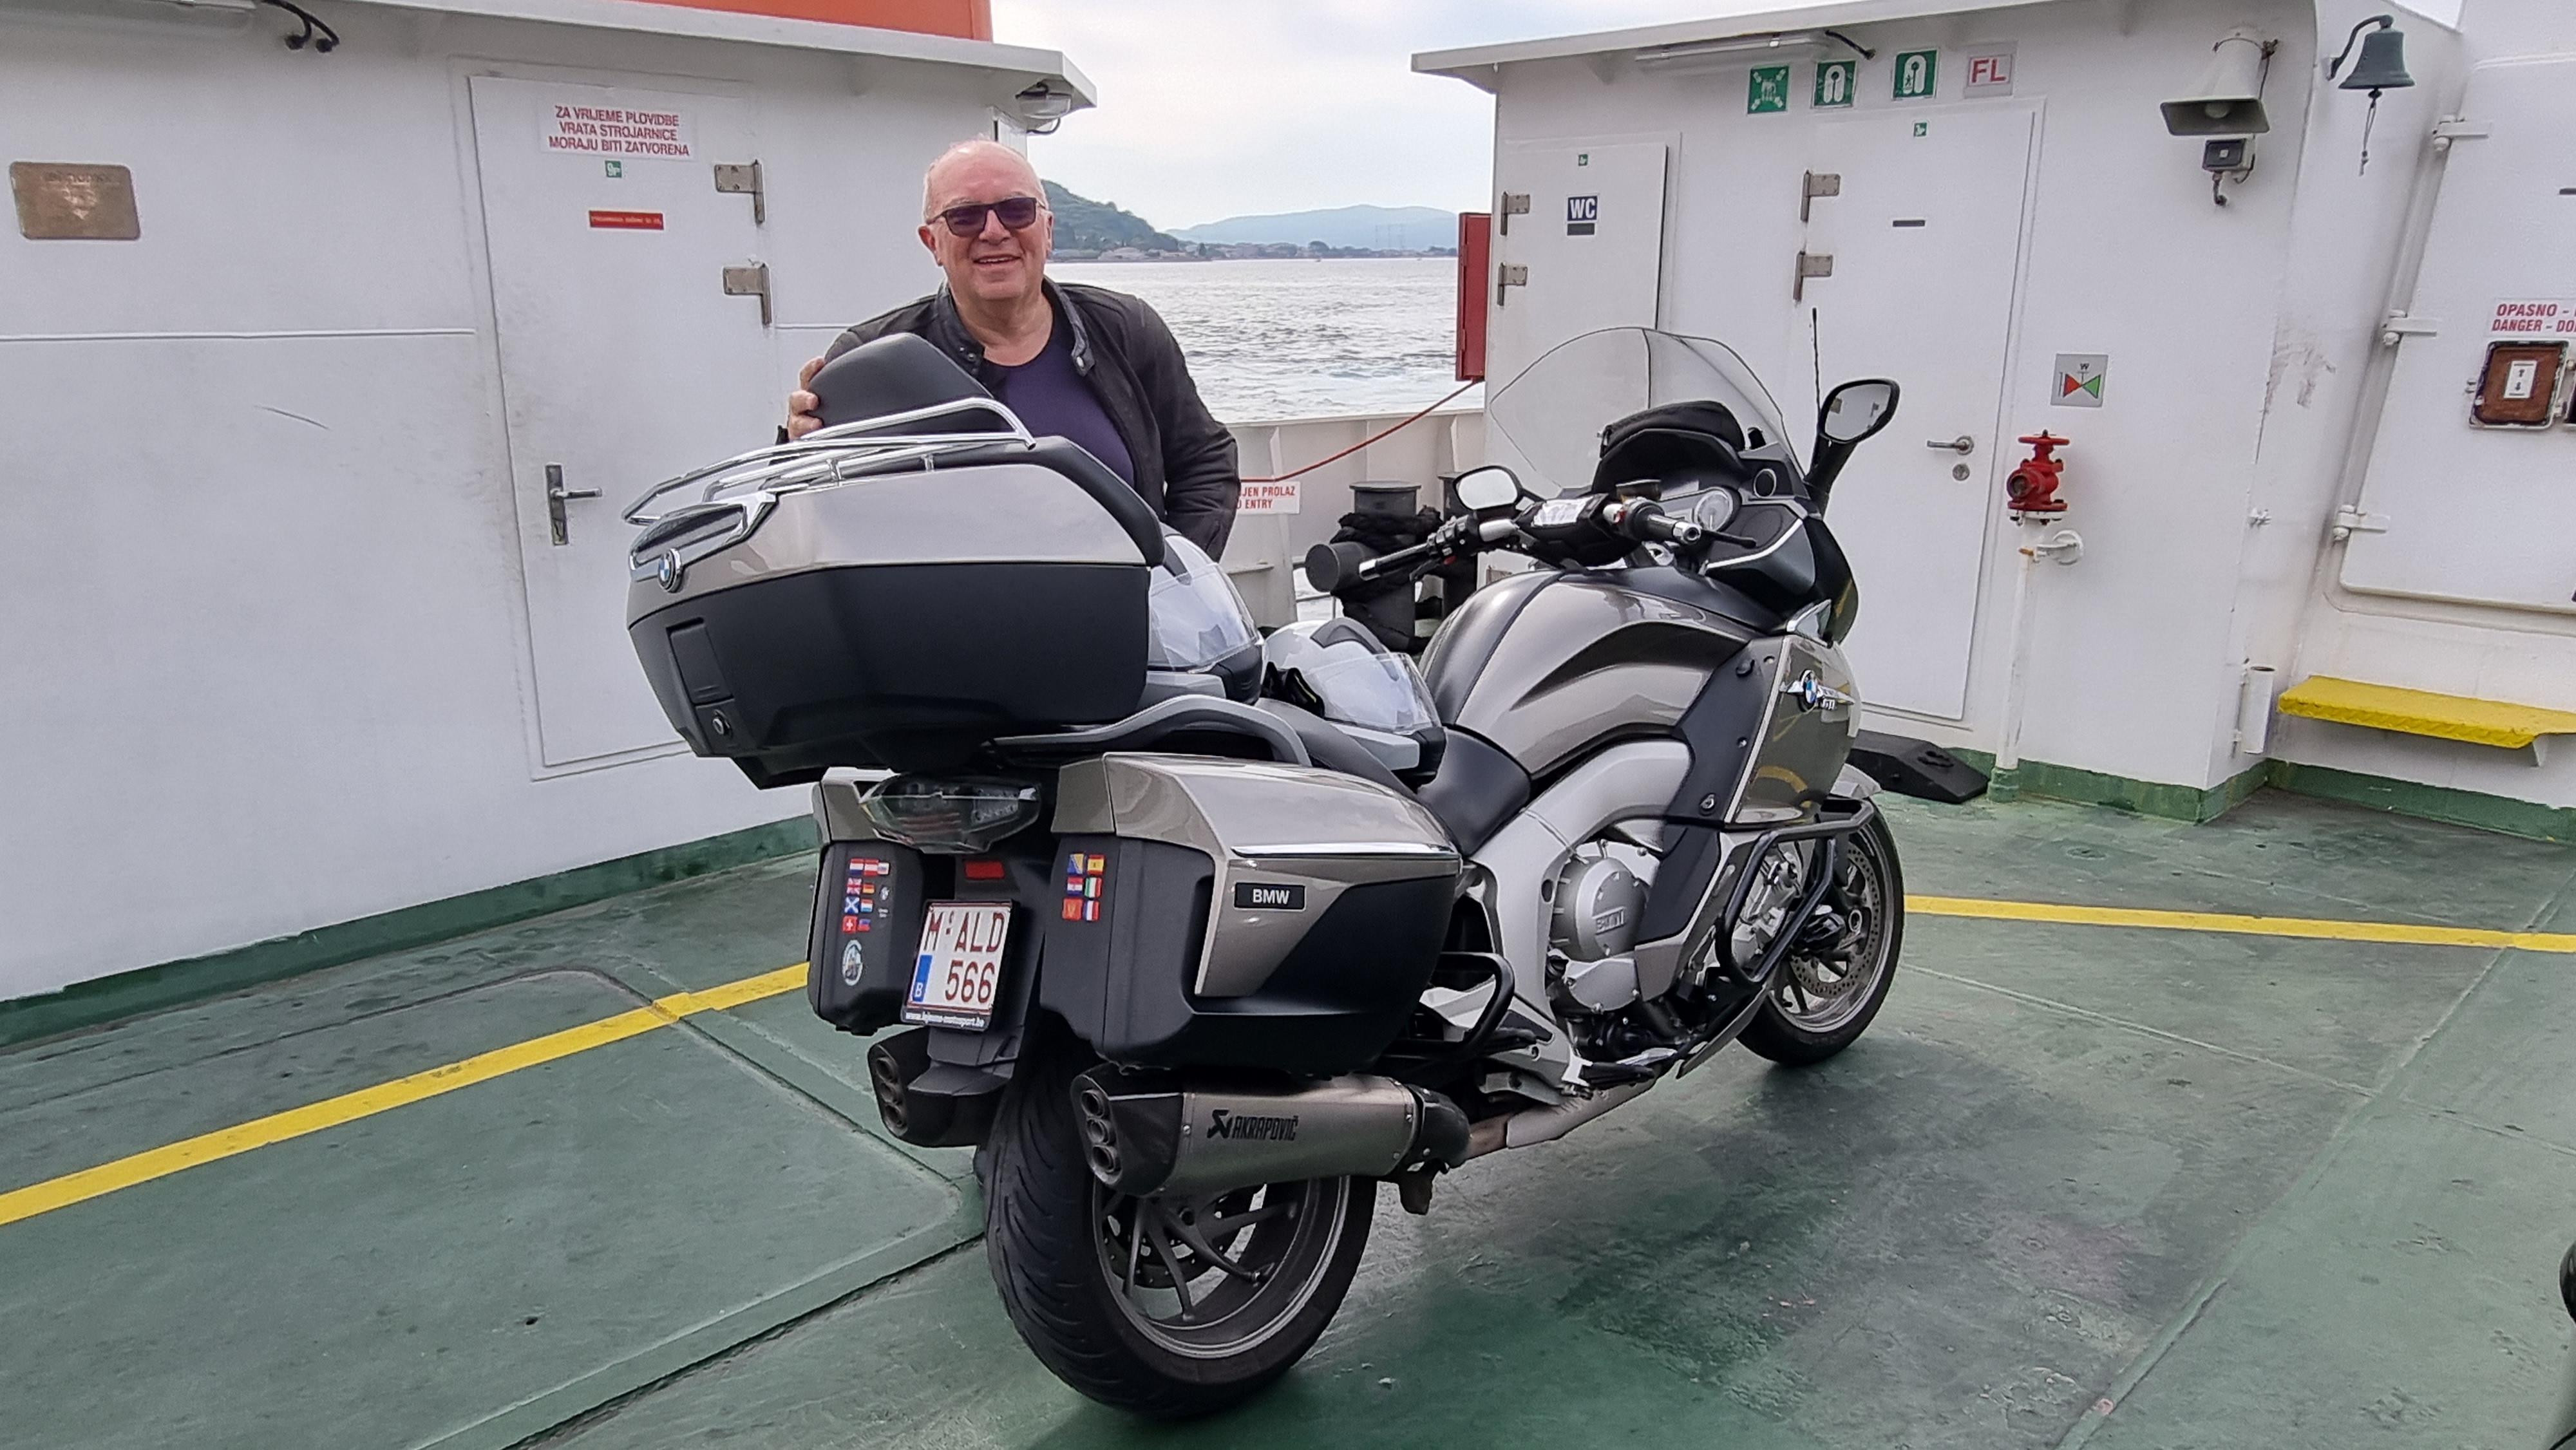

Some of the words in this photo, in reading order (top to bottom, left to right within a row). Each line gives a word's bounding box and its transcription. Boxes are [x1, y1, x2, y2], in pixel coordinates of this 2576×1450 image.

[1972, 59, 2006, 83] FL
[555, 105, 571, 118] ZA
[573, 107, 623, 122] VRIJEME
[627, 111, 679, 126] PLOVIDBE
[560, 121, 597, 136] VRATA
[600, 125, 677, 141] STROJARNICE
[549, 136, 598, 150] MORAJU
[601, 139, 621, 153] BITI
[625, 140, 690, 156] ZATVORENA
[1570, 198, 1595, 219] WC
[2496, 303, 2557, 317] OPASNO
[2492, 319, 2543, 332] DANGER
[2556, 320, 2576, 332] DO
[1238, 486, 1259, 497] JEN
[1262, 485, 1296, 497] PROLAZ
[1245, 499, 1273, 509] ENTRY
[1253, 889, 1290, 905] BMW
[914, 983, 923, 997] B
[945, 959, 996, 1004] 566
[1231, 1115, 1299, 1141] AKRAPOVIČ
